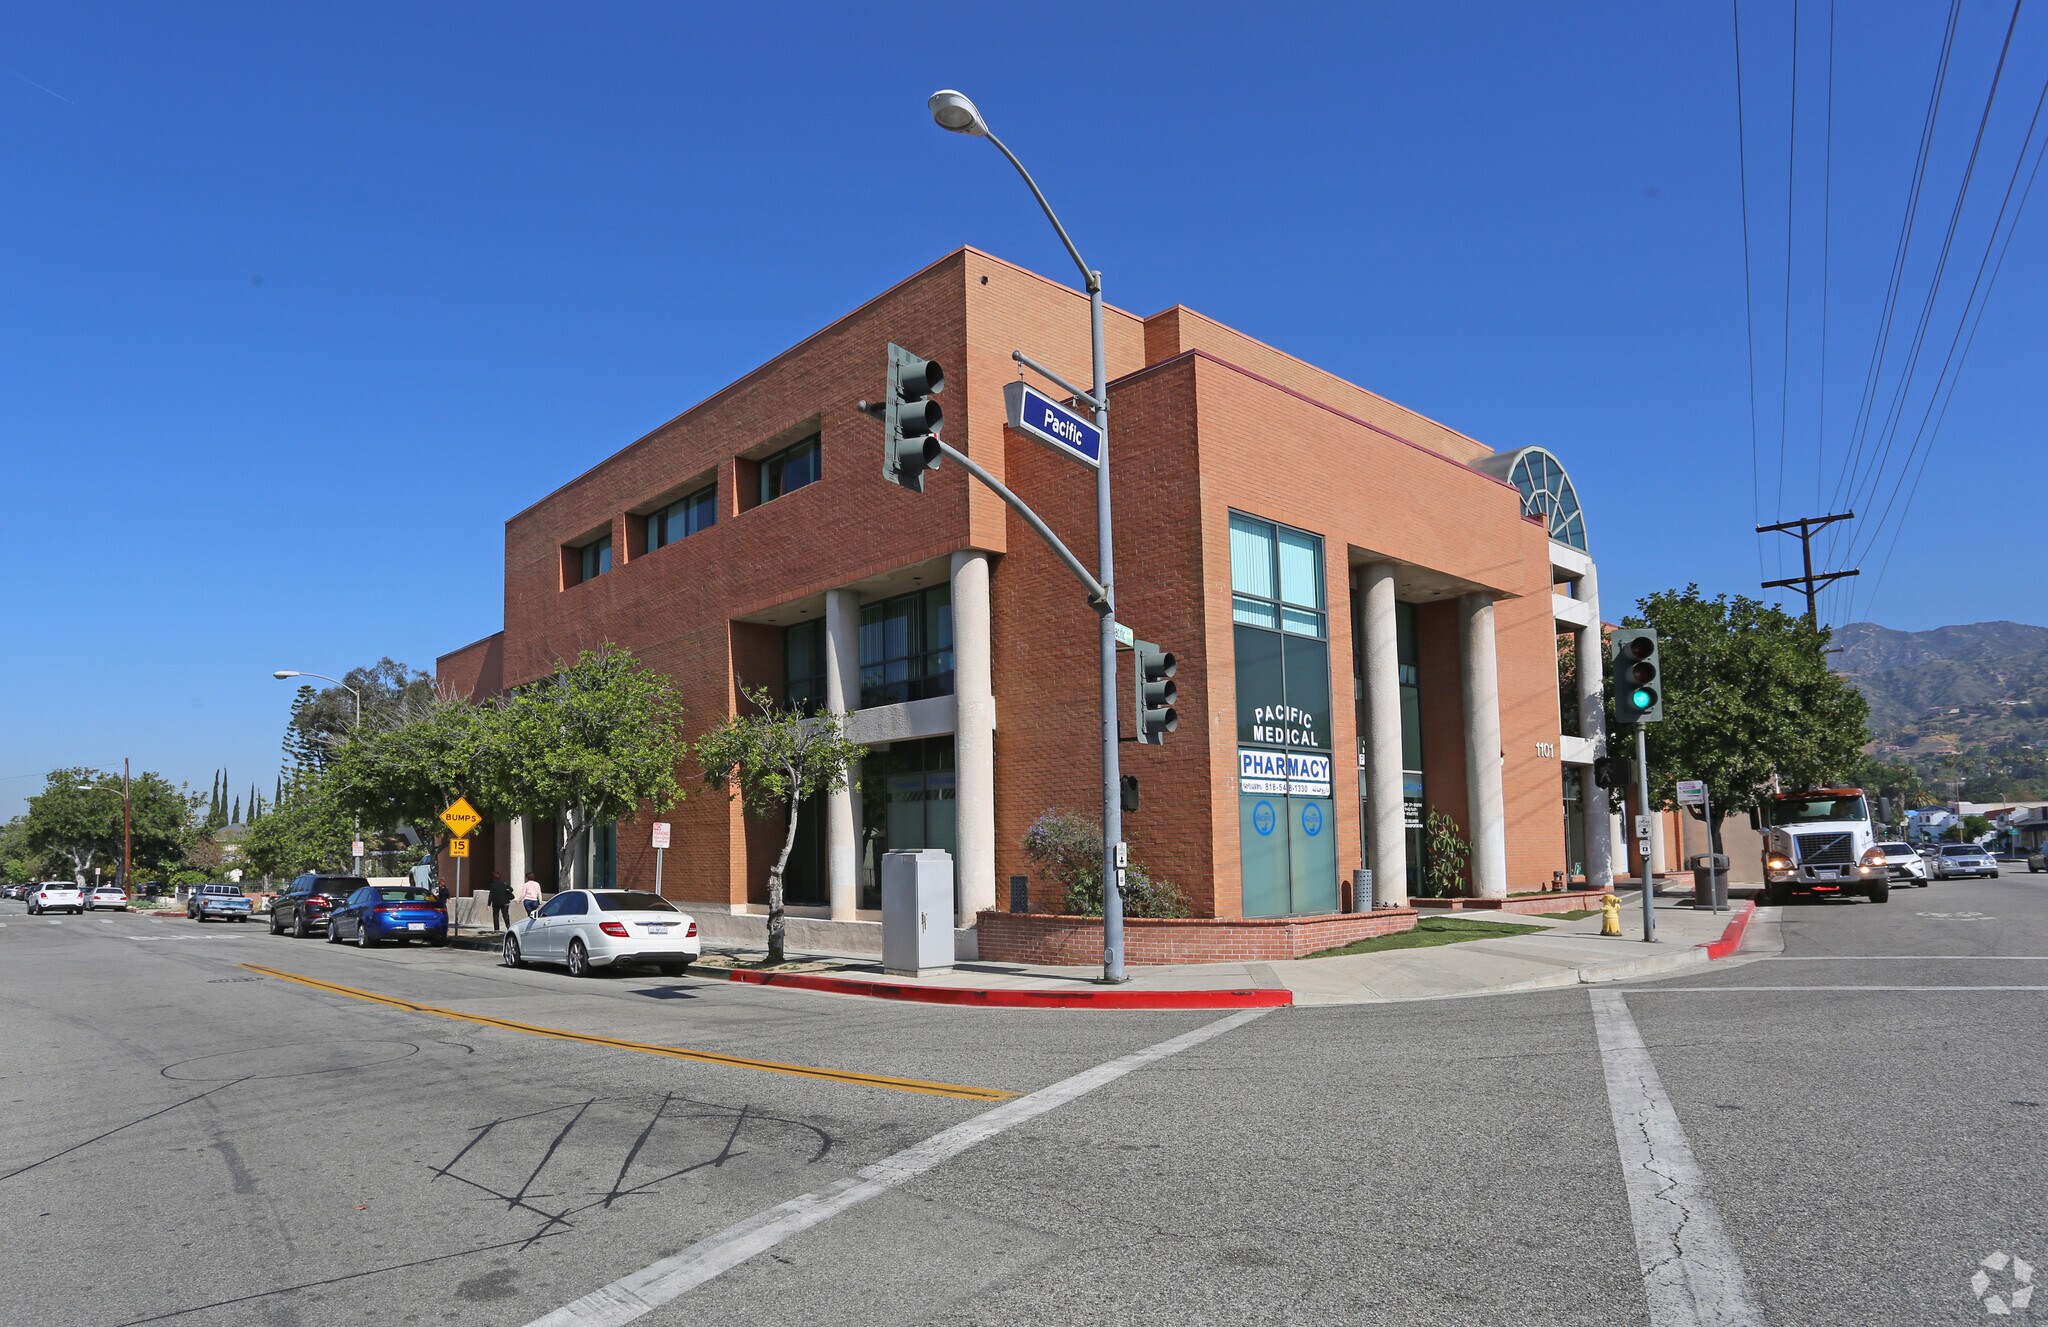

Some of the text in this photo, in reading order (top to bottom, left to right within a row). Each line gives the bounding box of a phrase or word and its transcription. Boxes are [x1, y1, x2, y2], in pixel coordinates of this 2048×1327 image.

[1043, 408, 1083, 446] Pacific
[1254, 704, 1313, 729] PACIFIC
[1253, 725, 1319, 747] MEDICAL
[1535, 741, 1554, 759] 1101
[1243, 754, 1328, 778] PHARMACY
[445, 813, 477, 823] BUMPS
[453, 841, 465, 850] 15
